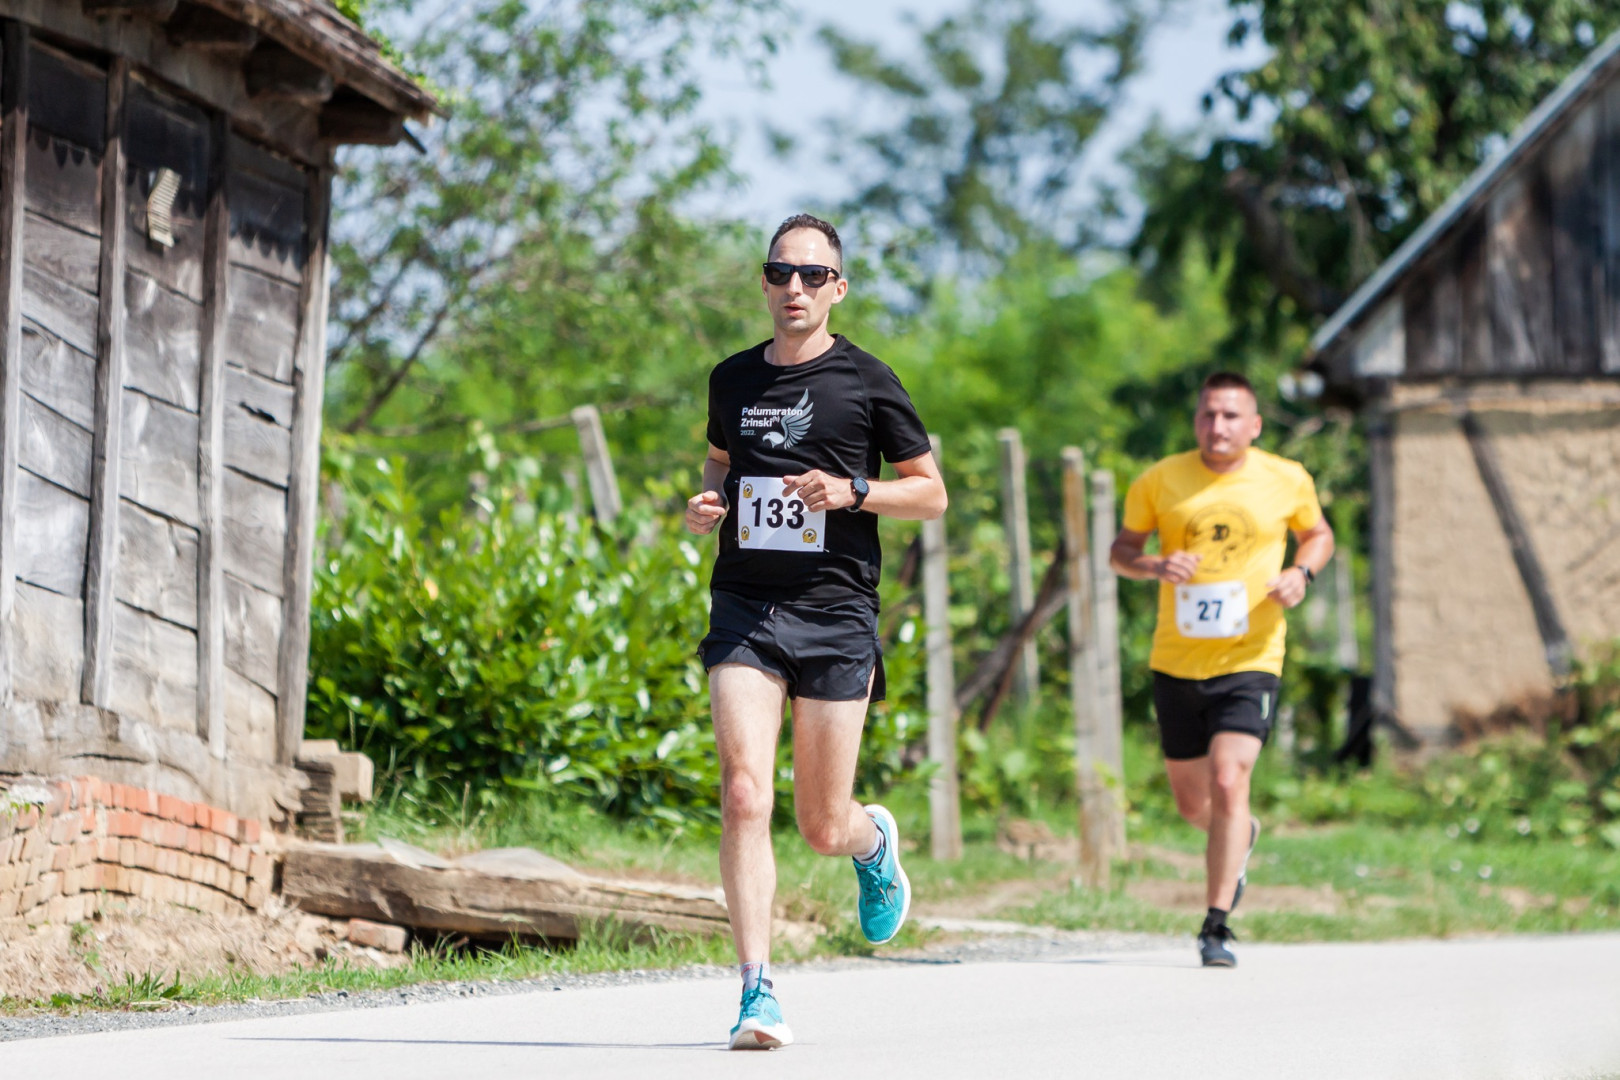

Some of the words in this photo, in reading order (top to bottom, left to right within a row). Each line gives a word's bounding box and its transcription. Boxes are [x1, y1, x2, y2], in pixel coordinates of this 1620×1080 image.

[741, 406, 803, 416] Polumaraton
[752, 497, 804, 529] 133
[1197, 600, 1223, 621] 27
